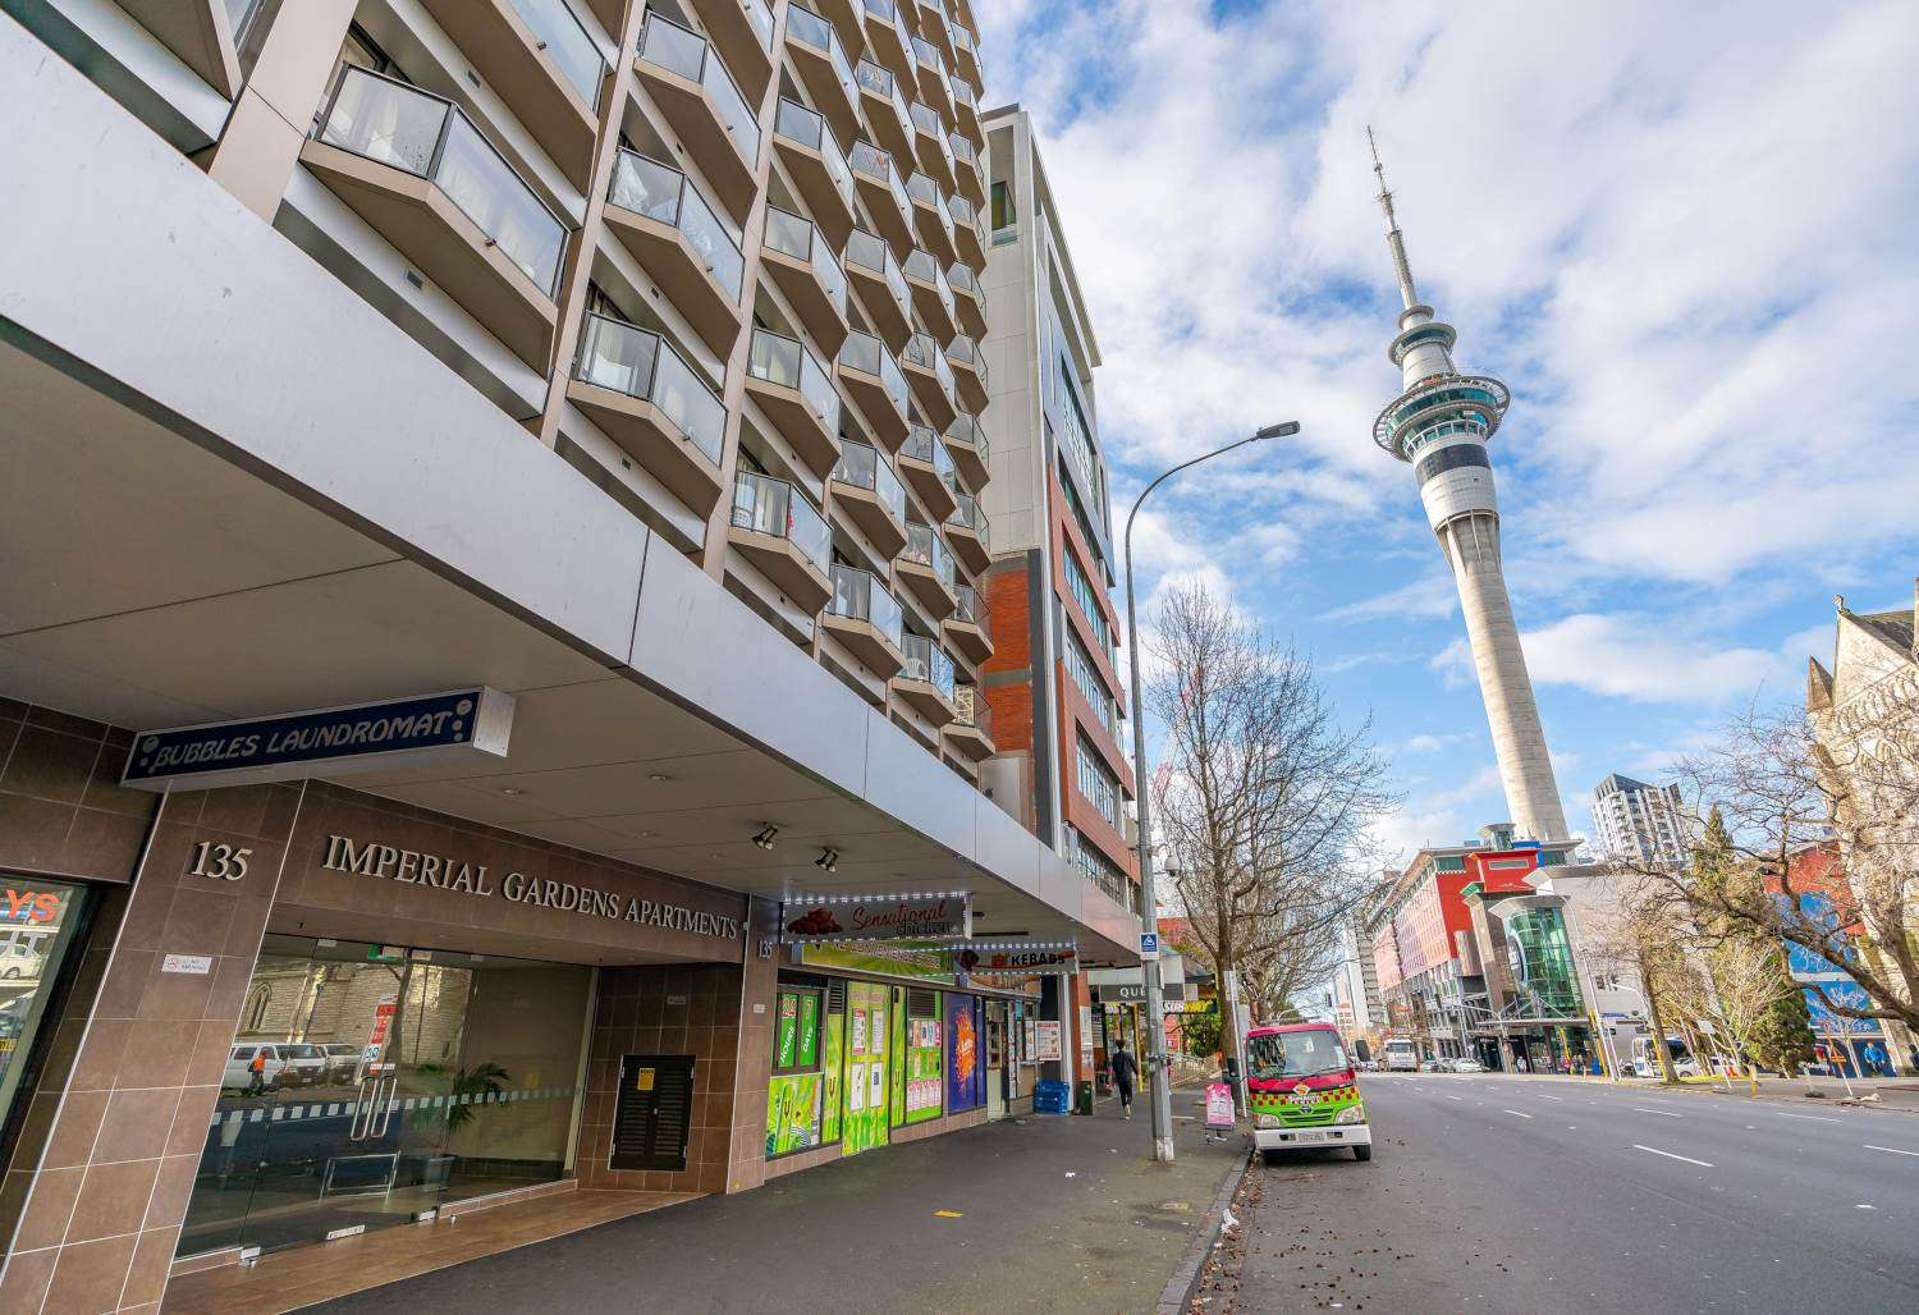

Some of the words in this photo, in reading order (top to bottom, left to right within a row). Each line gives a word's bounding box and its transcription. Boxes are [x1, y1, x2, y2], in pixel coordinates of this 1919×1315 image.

[155, 735, 260, 768] BUBBLES
[265, 711, 453, 753] LAUNDROMAT
[192, 841, 253, 881] 135
[322, 834, 493, 896] IMPERIAL
[503, 873, 620, 919] GARDENS
[625, 898, 737, 940] APARTMENTS
[852, 900, 946, 931] Sensational
[1011, 952, 1065, 966] KEBABS
